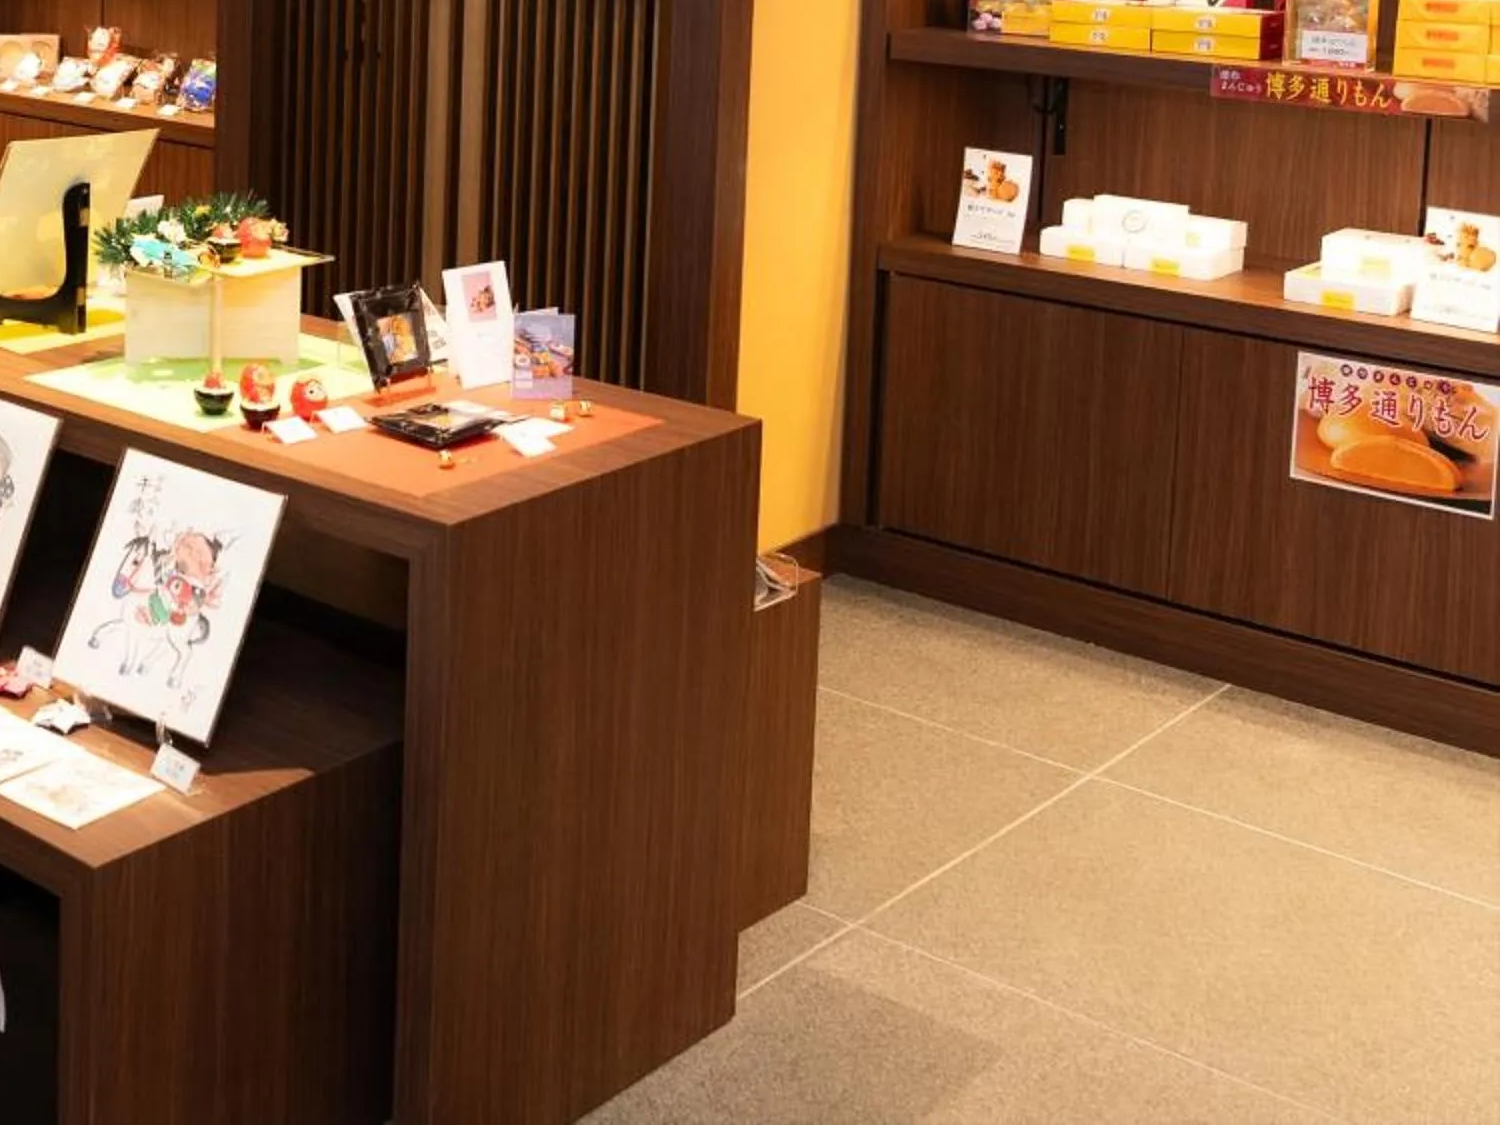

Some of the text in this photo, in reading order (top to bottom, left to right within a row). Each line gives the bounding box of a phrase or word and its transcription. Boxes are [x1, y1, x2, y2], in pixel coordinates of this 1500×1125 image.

[1266, 71, 1393, 108] 博多通りもん
[1307, 376, 1488, 441] 博多通りもん
